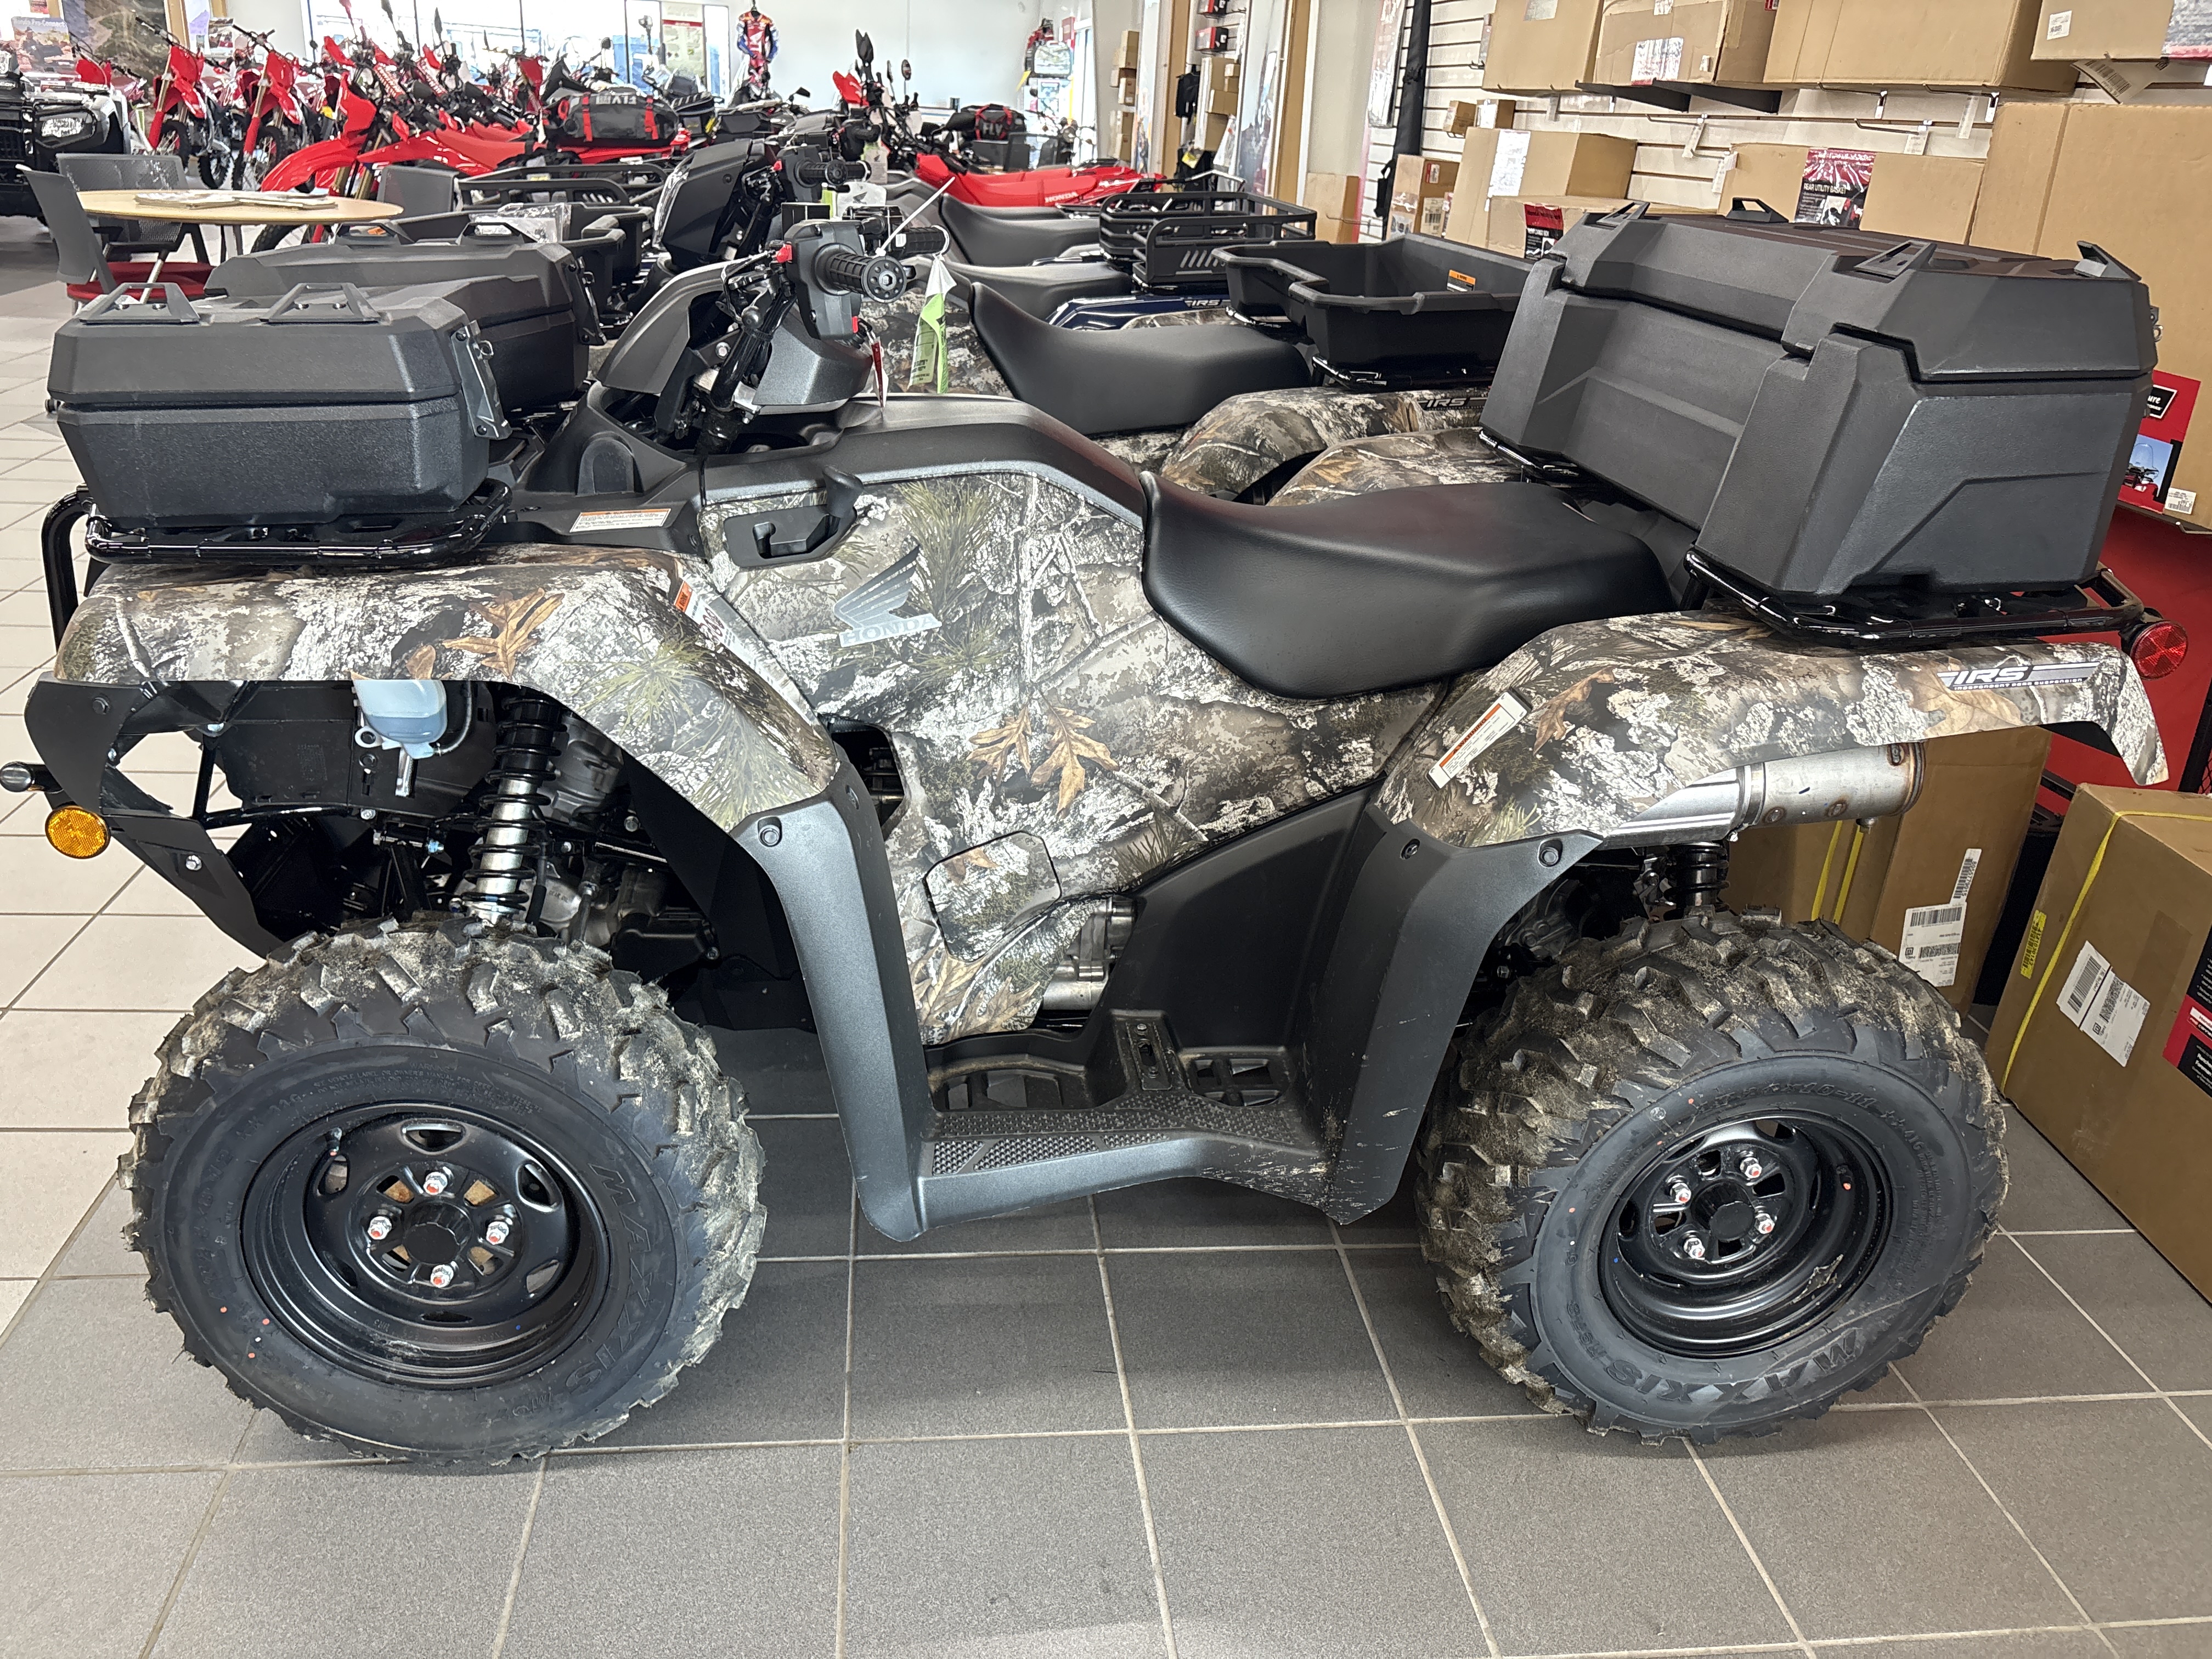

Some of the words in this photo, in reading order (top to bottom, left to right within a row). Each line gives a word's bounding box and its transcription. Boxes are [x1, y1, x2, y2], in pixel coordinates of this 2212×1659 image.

[612, 95, 637, 105] FLY
[1045, 191, 1079, 204] HONDA
[1427, 398, 1467, 408] IRS
[841, 616, 939, 645] HONDA
[1954, 667, 2029, 685] IRS
[1458, 718, 1487, 748] WARNING
[566, 1162, 652, 1393] MAXXIS
[1605, 1328, 1865, 1402] MAXXIS
